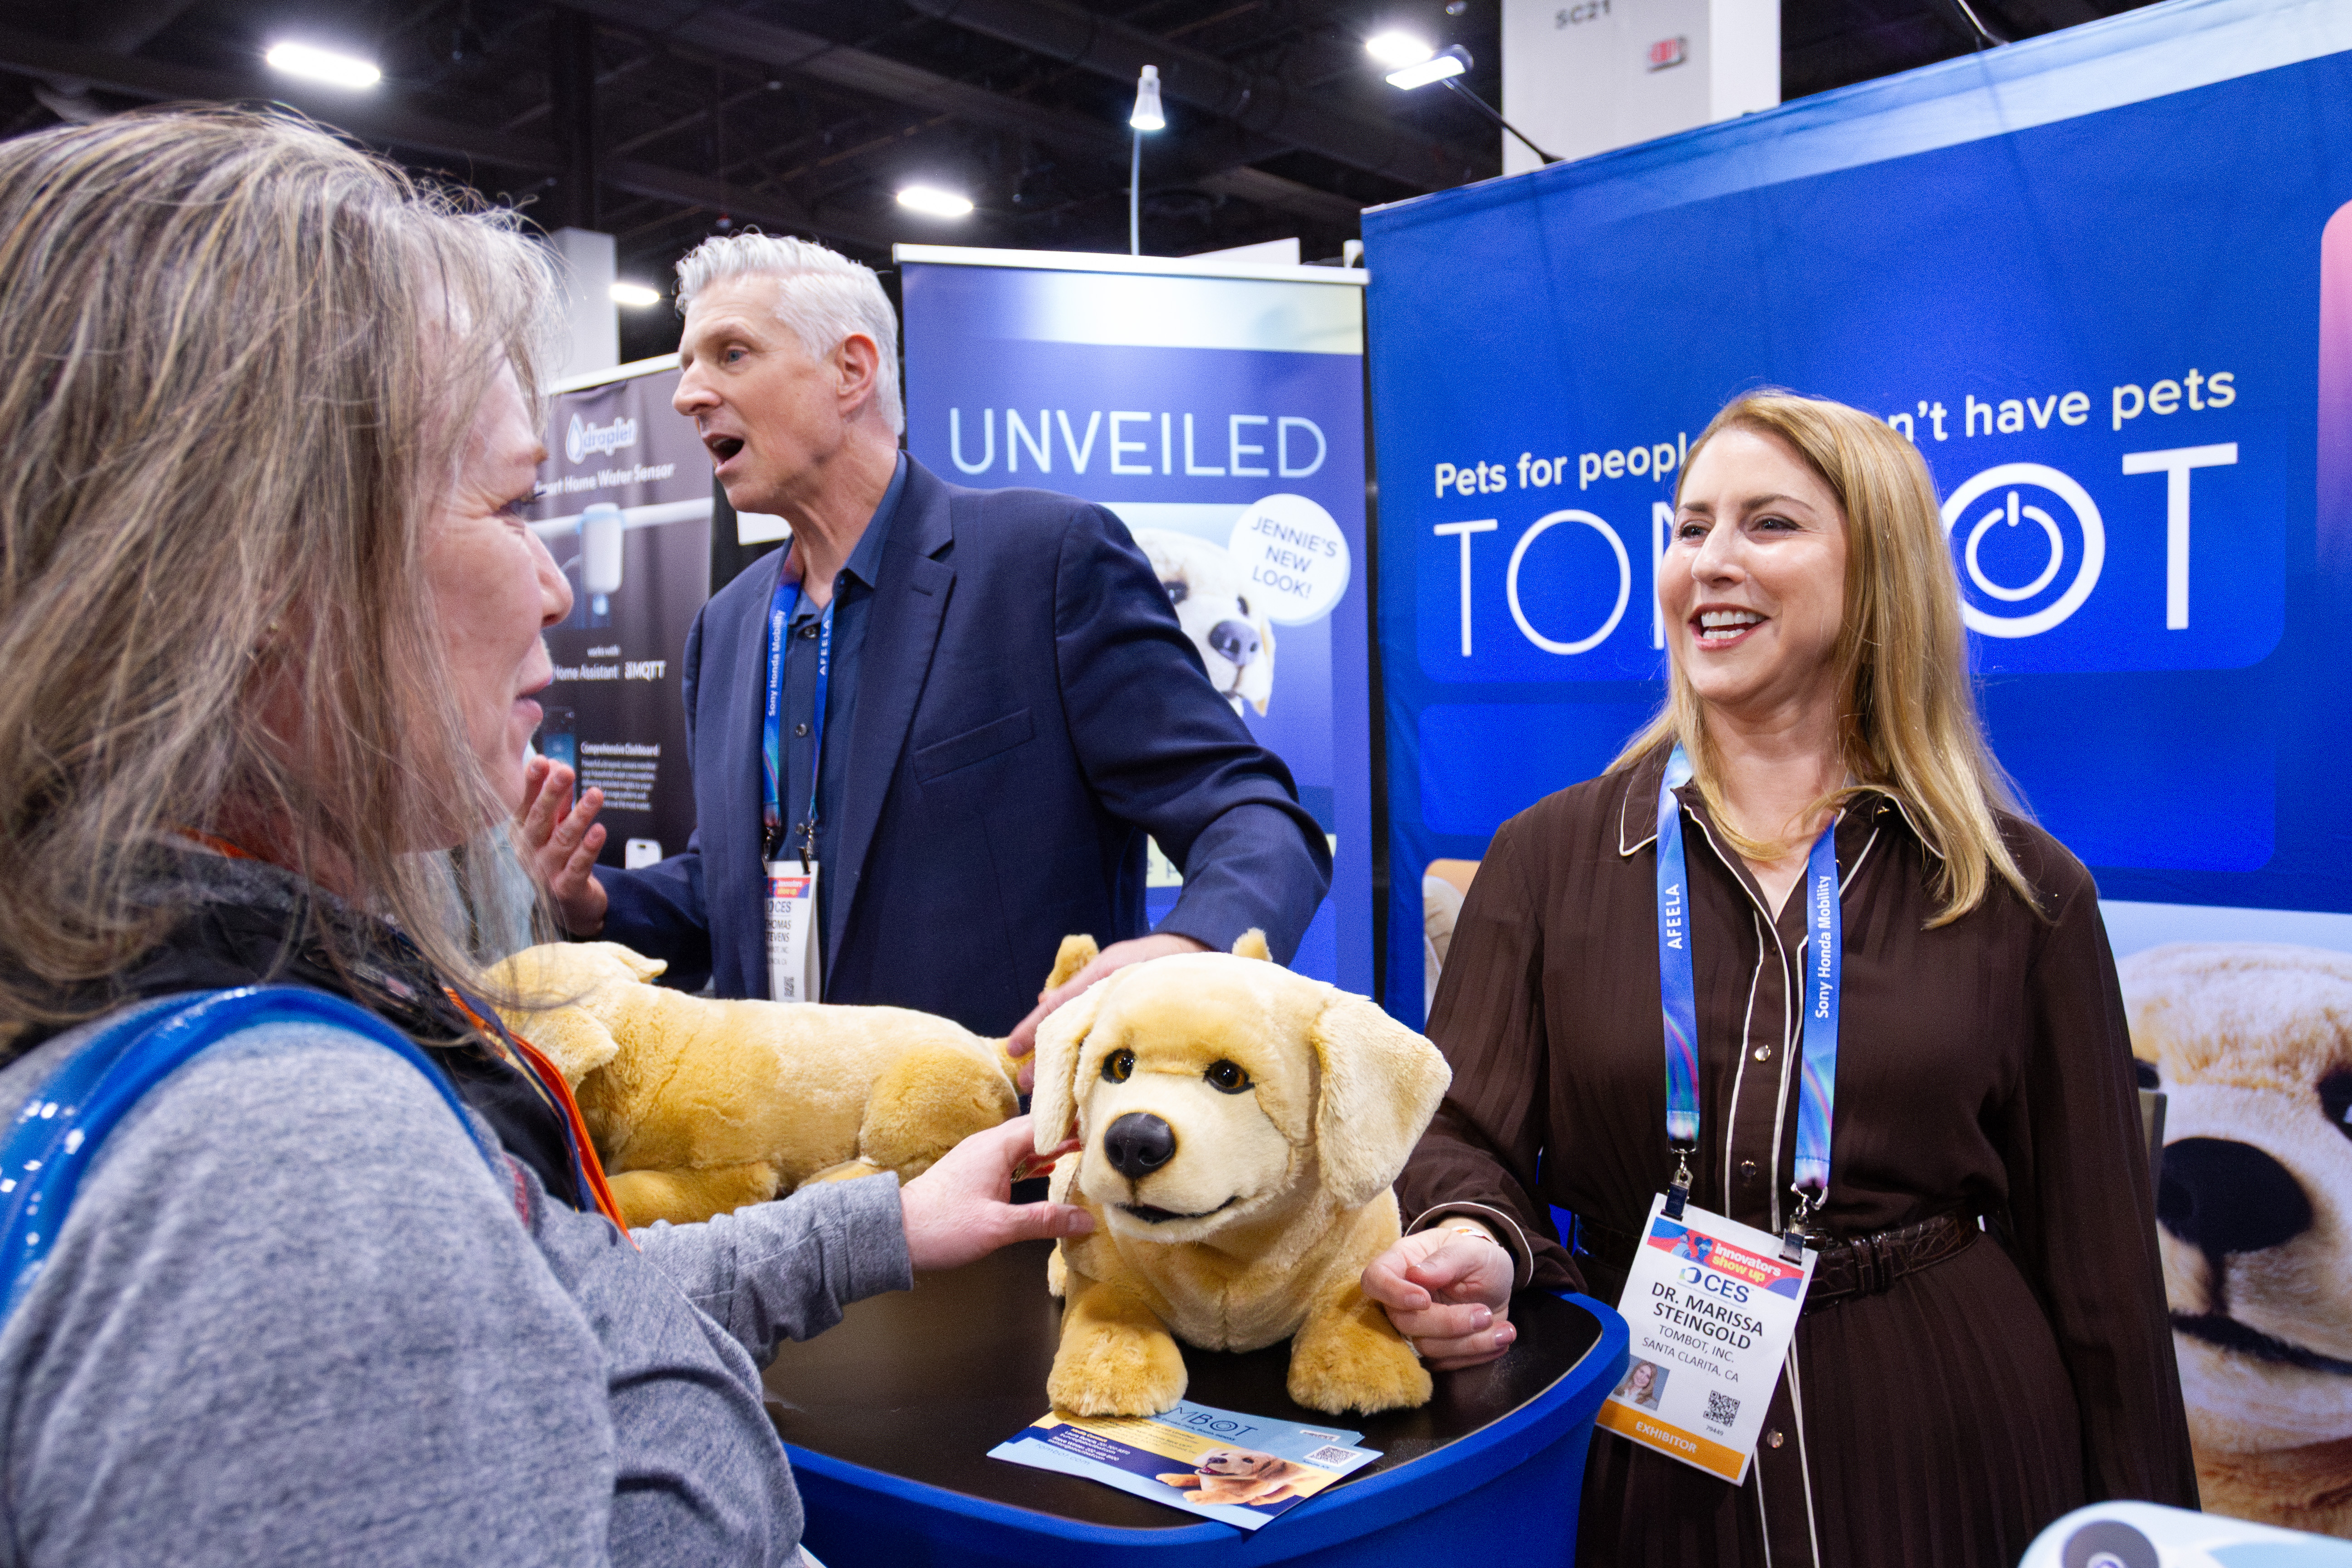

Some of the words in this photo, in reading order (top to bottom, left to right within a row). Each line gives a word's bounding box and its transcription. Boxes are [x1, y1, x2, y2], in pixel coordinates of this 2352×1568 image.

[949, 407, 1328, 479] UNVEILED
[1435, 461, 1507, 499] Pets
[1516, 451, 1568, 489] for
[1579, 431, 1692, 491] peopl
[1888, 400, 1949, 443] n't
[1965, 394, 2091, 438] have
[2112, 368, 2236, 432] pets
[564, 475, 598, 493] Home
[598, 468, 633, 488] Water
[633, 462, 675, 482] Sensor
[1251, 515, 1338, 558] JENNIE'S
[1264, 544, 1313, 573] NEW
[1252, 565, 1312, 599] LOOK!
[819, 619, 830, 676] AFEELA
[770, 653, 779, 689] Honda
[768, 690, 778, 717] Sony
[775, 901, 791, 914] CES
[1665, 883, 1683, 950] AFEELA
[1817, 876, 1832, 929] Mobility
[1818, 932, 1832, 978] Honda
[1815, 981, 1833, 1019] Sony
[1712, 1255, 1747, 1275] show
[1748, 1269, 1765, 1283] up
[1715, 1243, 1782, 1276] innovators
[1704, 1274, 1750, 1303] CES
[1651, 1282, 1679, 1304] DR.
[1685, 1294, 1763, 1337] MARISSA
[1653, 1302, 1751, 1349] STEINGOLD
[1642, 1337, 1675, 1357] SANTA
[1725, 1370, 1739, 1382] CA
[1659, 1324, 1709, 1354] TOMBOT,
[1711, 1345, 1734, 1363] INC.
[1635, 1421, 1698, 1453] EXHIBITOR
